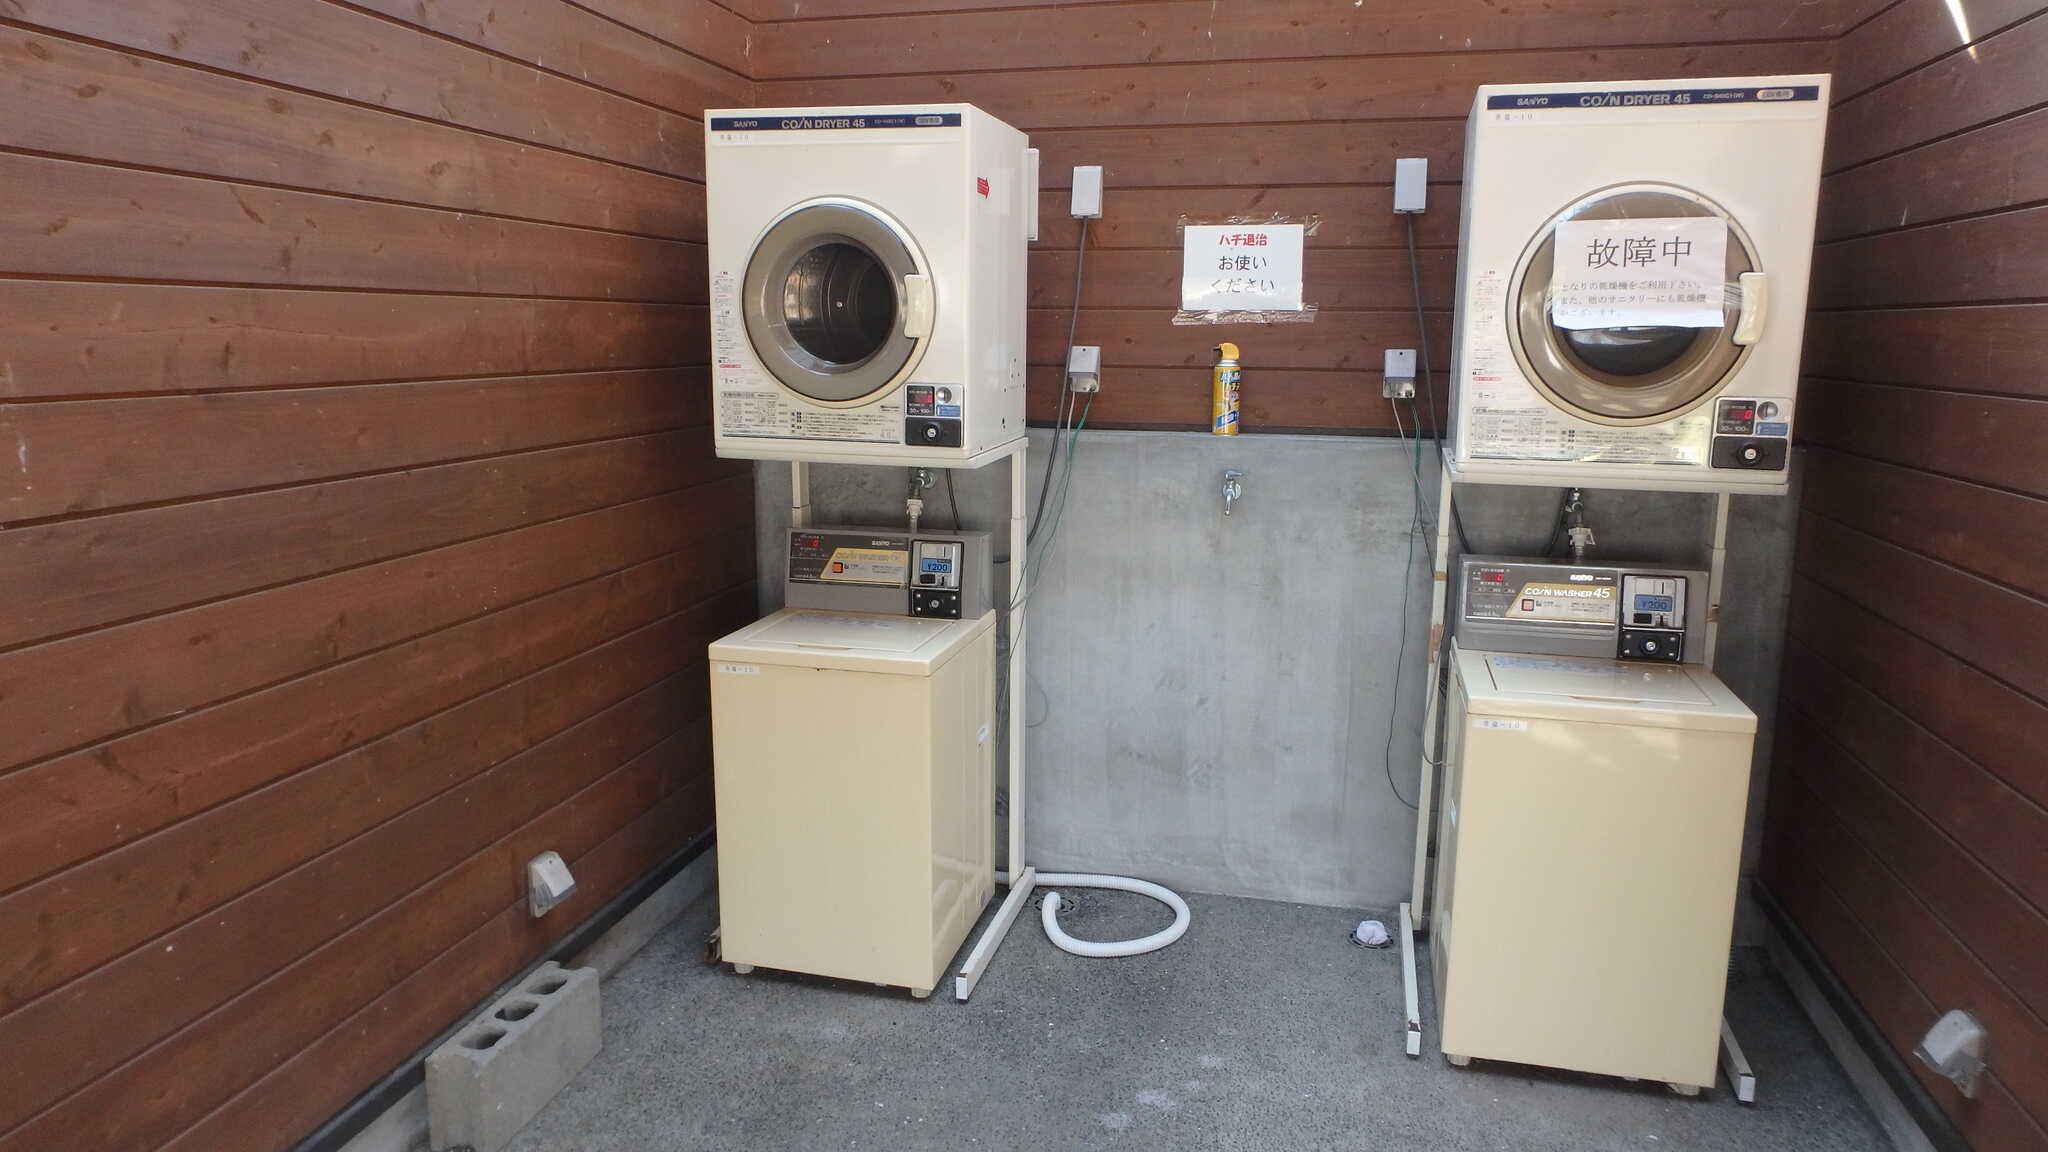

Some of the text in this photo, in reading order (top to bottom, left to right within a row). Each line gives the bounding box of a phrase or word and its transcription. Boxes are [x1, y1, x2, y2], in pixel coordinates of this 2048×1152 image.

[1516, 97, 1549, 106] SANYO
[1623, 94, 1671, 106] DRYER
[1673, 93, 1691, 104] 45
[734, 120, 758, 128] SANYO
[814, 119, 850, 129] DRYER
[852, 118, 865, 128] 45
[1218, 233, 1268, 247] ハチ退治
[1586, 235, 1691, 269] 故障中
[1218, 255, 1267, 271] お使い
[1210, 278, 1275, 294] ください
[1591, 587, 1611, 598] 45
